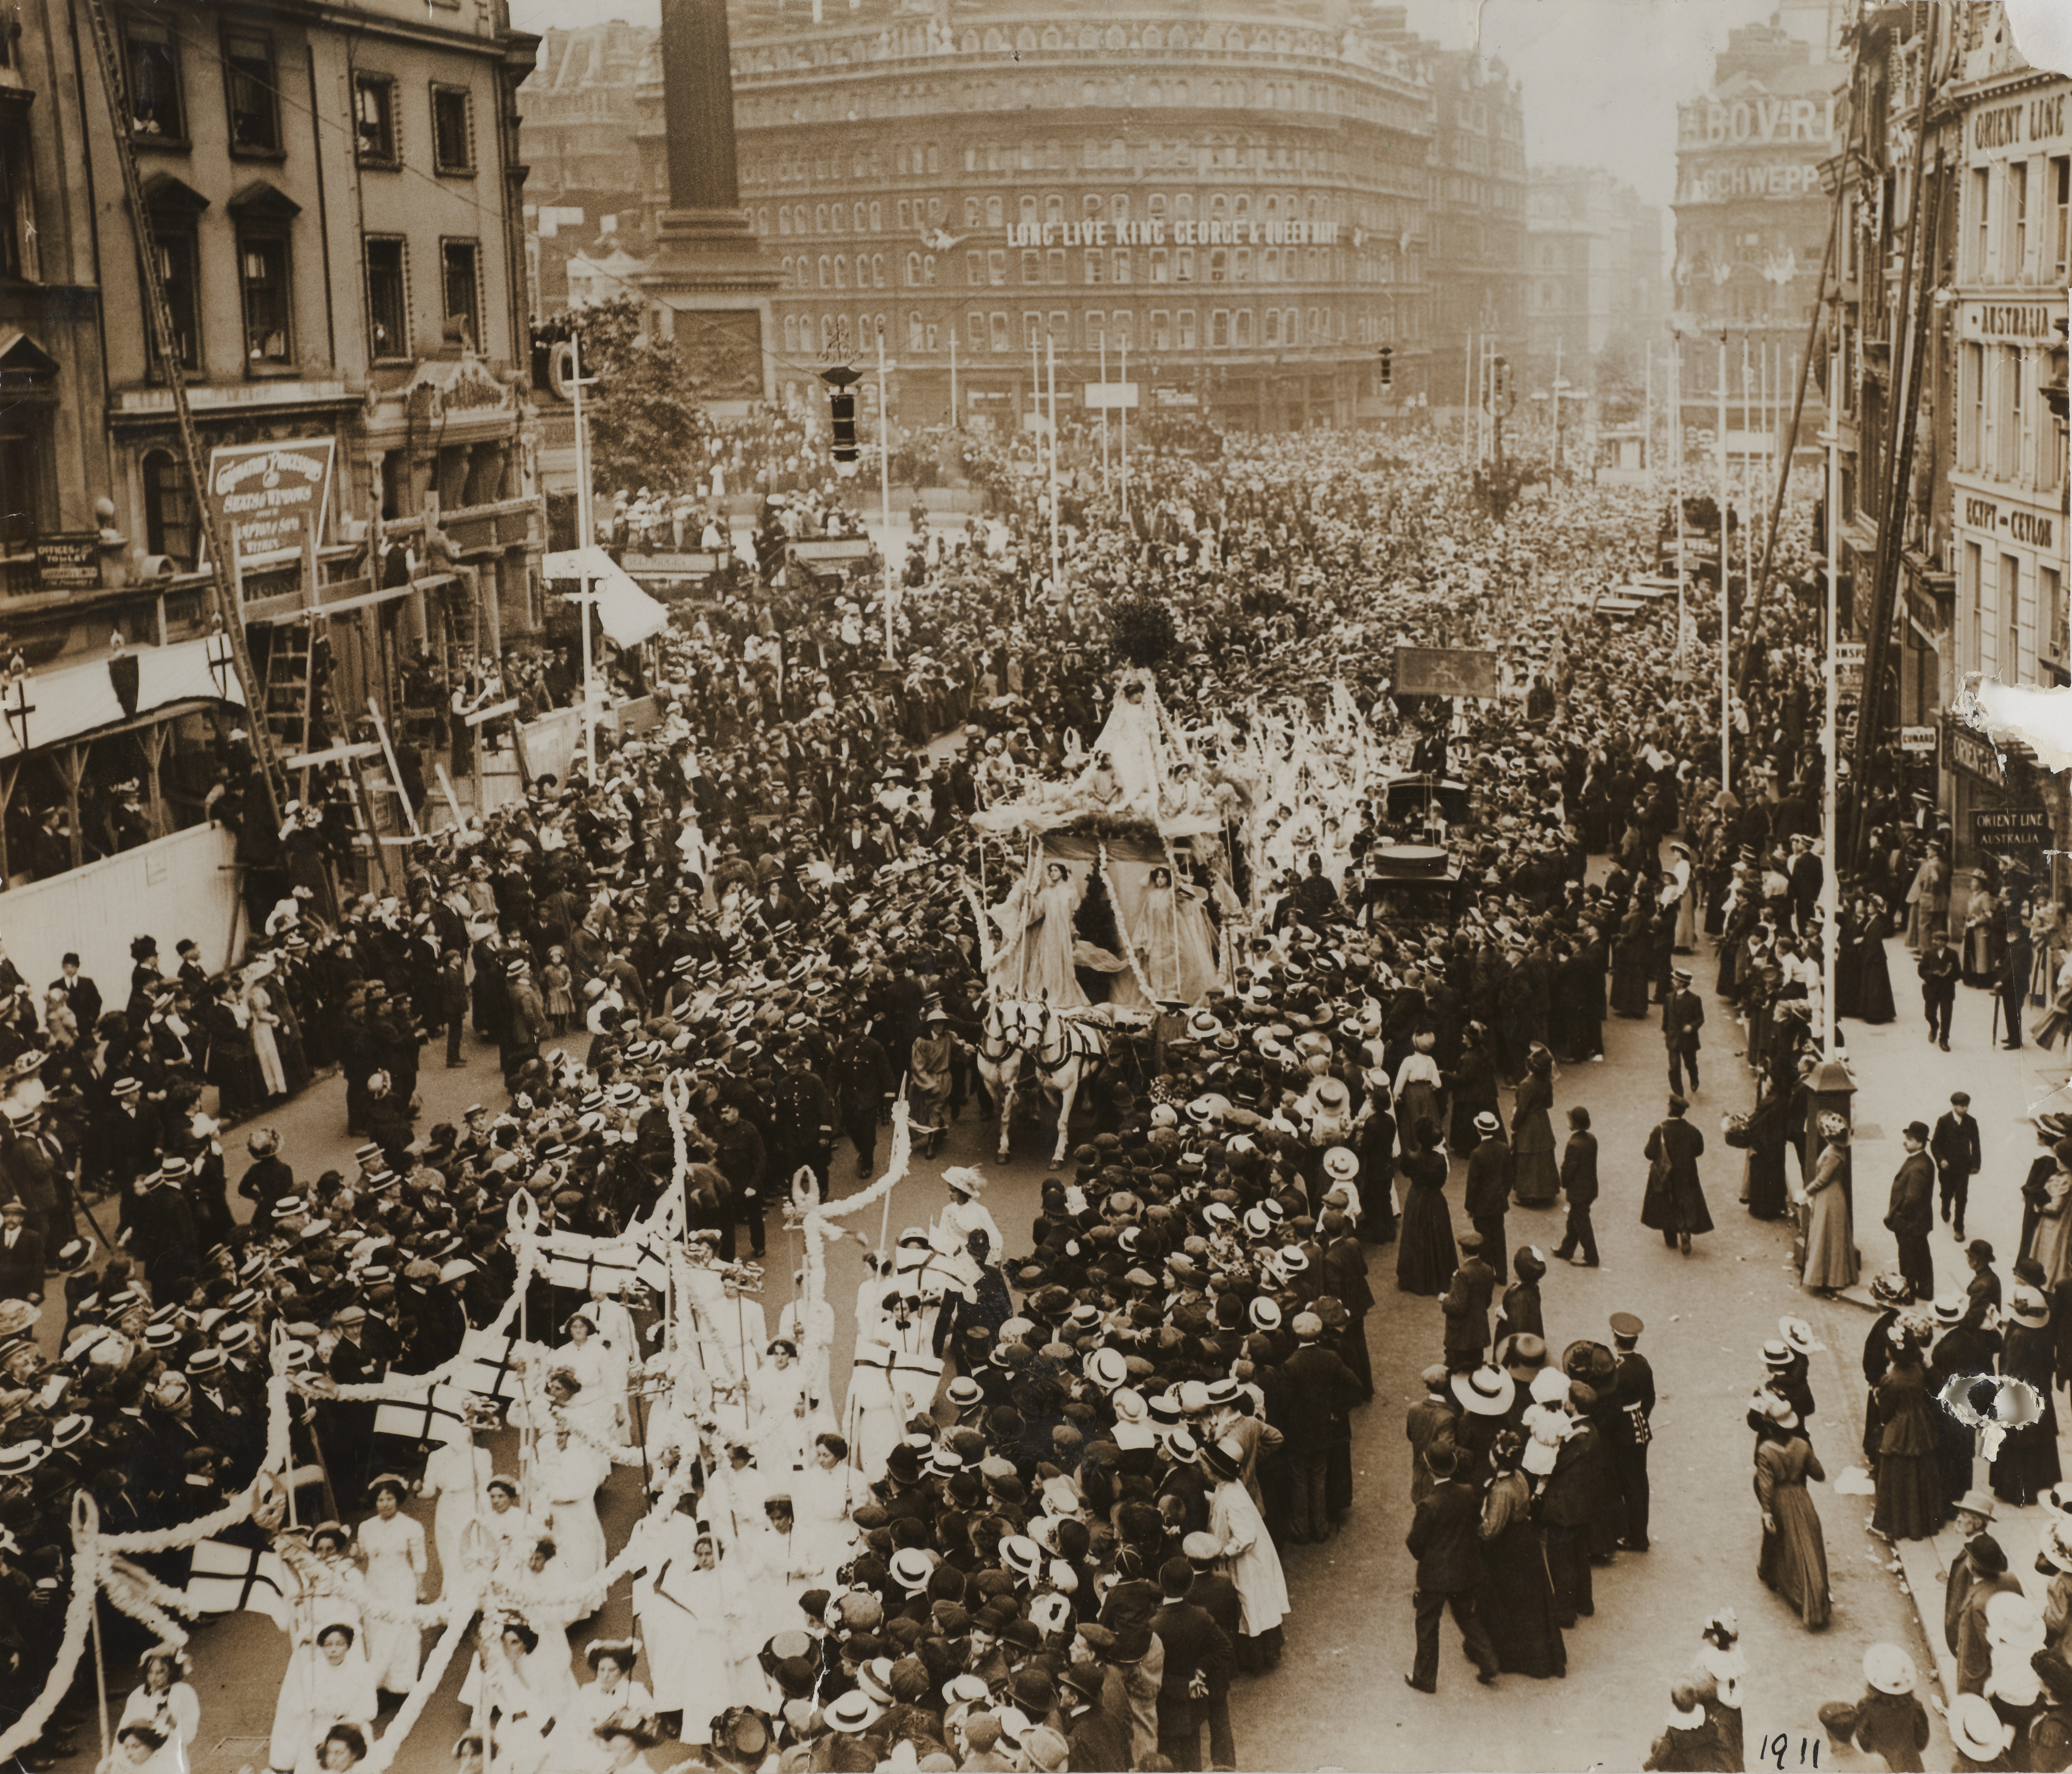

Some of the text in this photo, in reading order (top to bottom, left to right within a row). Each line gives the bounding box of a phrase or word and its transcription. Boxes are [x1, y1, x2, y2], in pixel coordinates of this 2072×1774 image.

[1706, 99, 1834, 144] BOVRI
[1975, 93, 2065, 150] ORIENT LINE
[1702, 165, 1820, 194] SCHWEPP
[1007, 221, 1054, 247] LONG
[1061, 221, 1108, 246] LIVE
[1116, 221, 1165, 245] KING
[1174, 220, 1243, 245] GEORGE
[1249, 221, 1259, 244] &
[1265, 220, 1308, 245] QUEEN
[1982, 305, 2049, 338] AUSTRALIA
[223, 493, 260, 514] SEATS
[268, 485, 312, 506] WINDOWS
[1966, 497, 1997, 531] EGYPT
[2011, 511, 2052, 548] CEYLON
[1903, 734, 1935, 743] CUNARD
[1977, 813, 2043, 827] ORIENT LINE
[1980, 833, 2039, 844] AUSTRALIA
